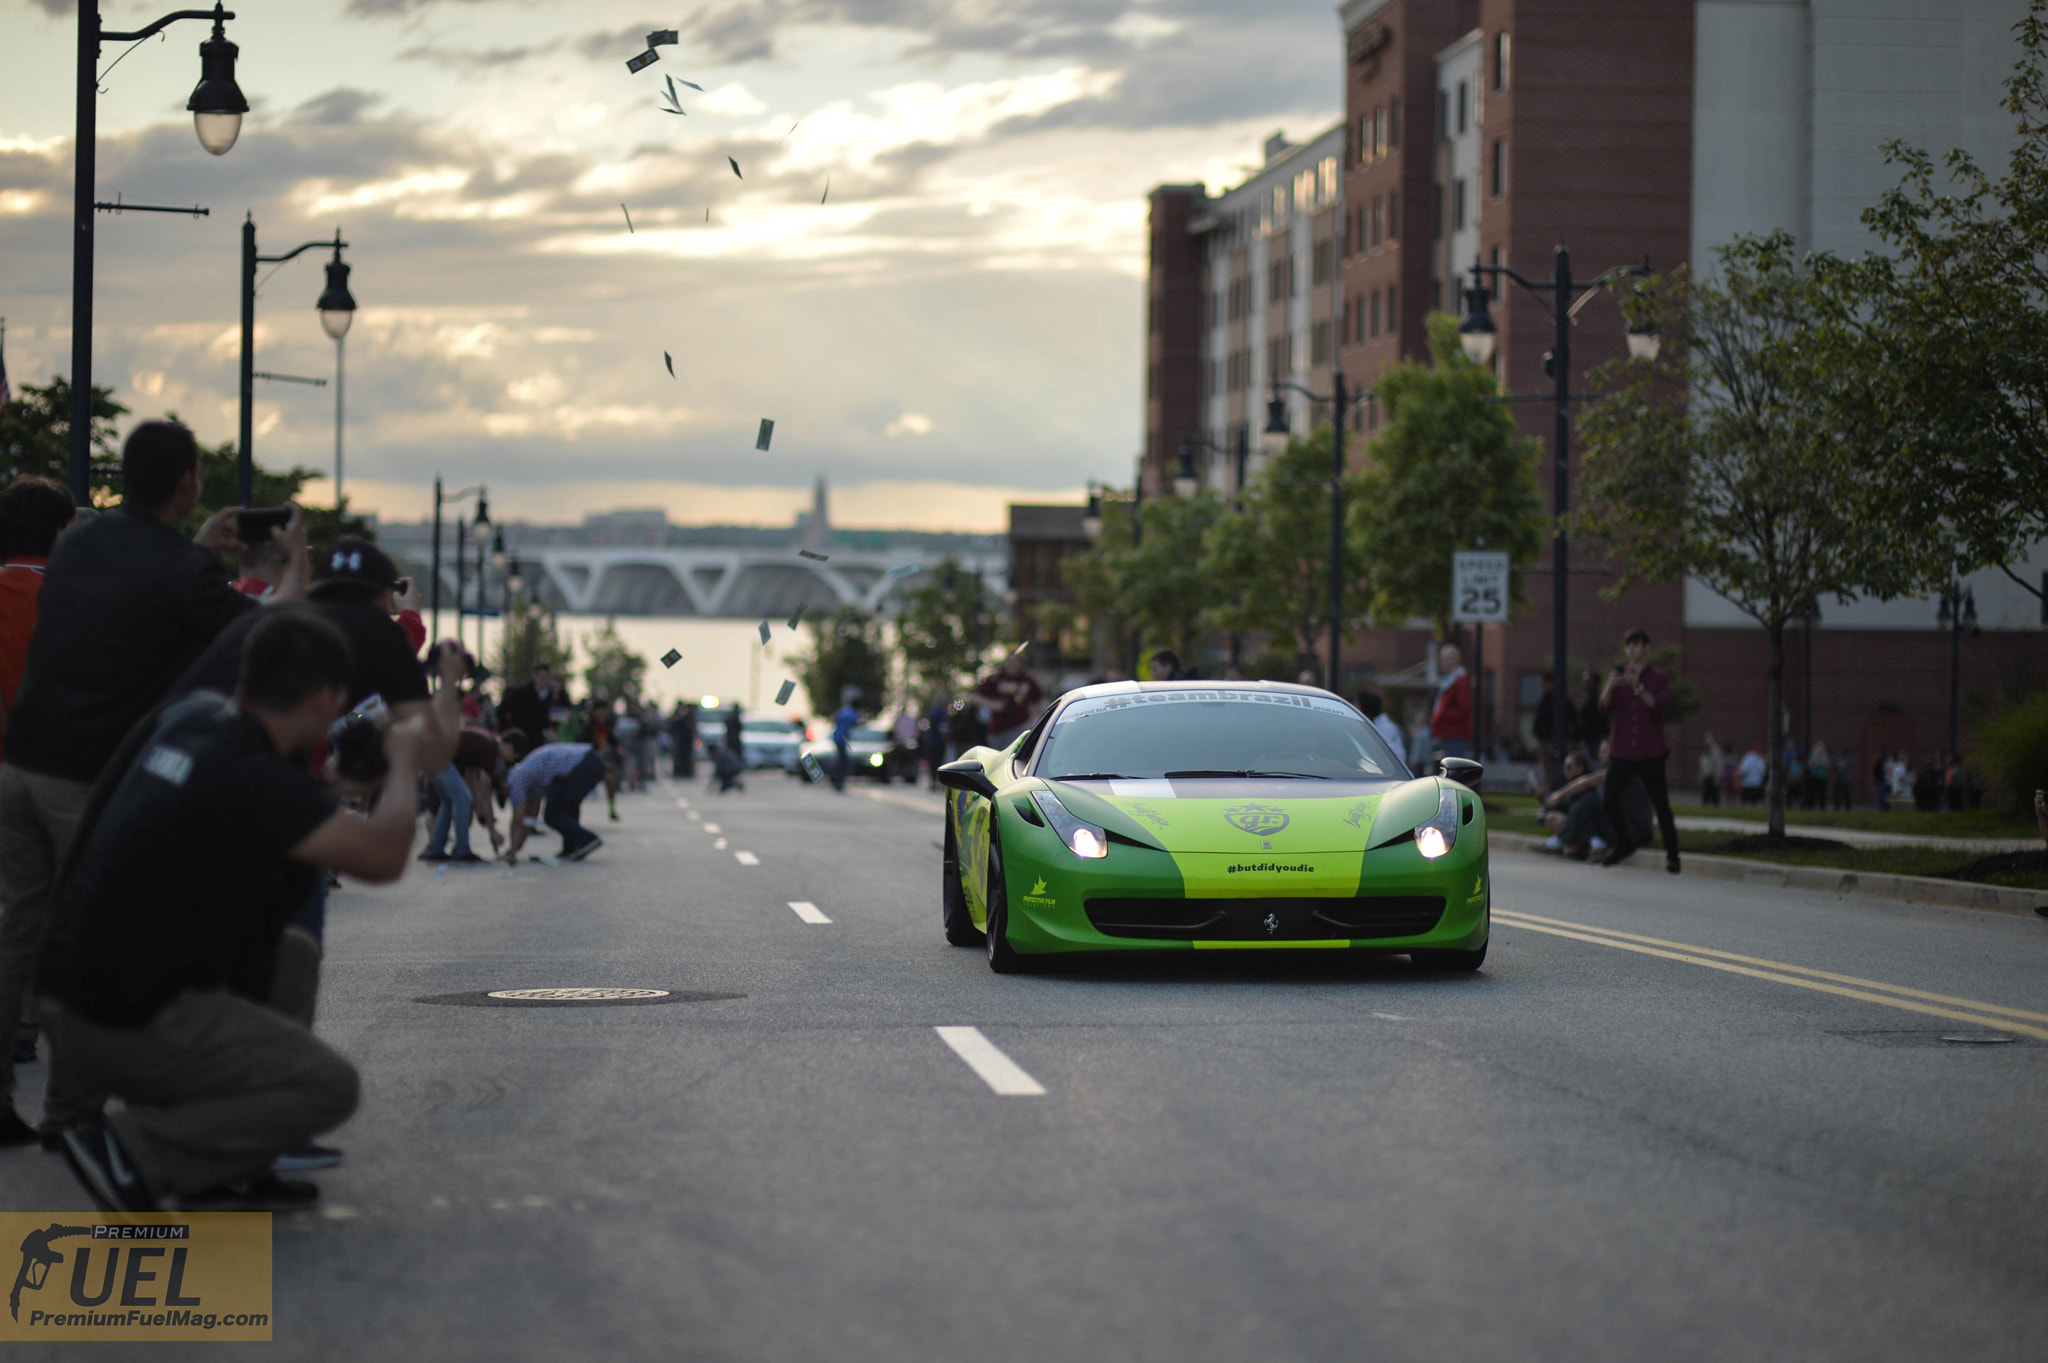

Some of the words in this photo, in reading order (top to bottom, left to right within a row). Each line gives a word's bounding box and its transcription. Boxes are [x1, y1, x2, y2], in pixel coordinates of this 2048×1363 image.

[1461, 587, 1501, 614] 25
[1104, 690, 1312, 710] #teambrazil
[1227, 863, 1315, 874] #butdidyoudie
